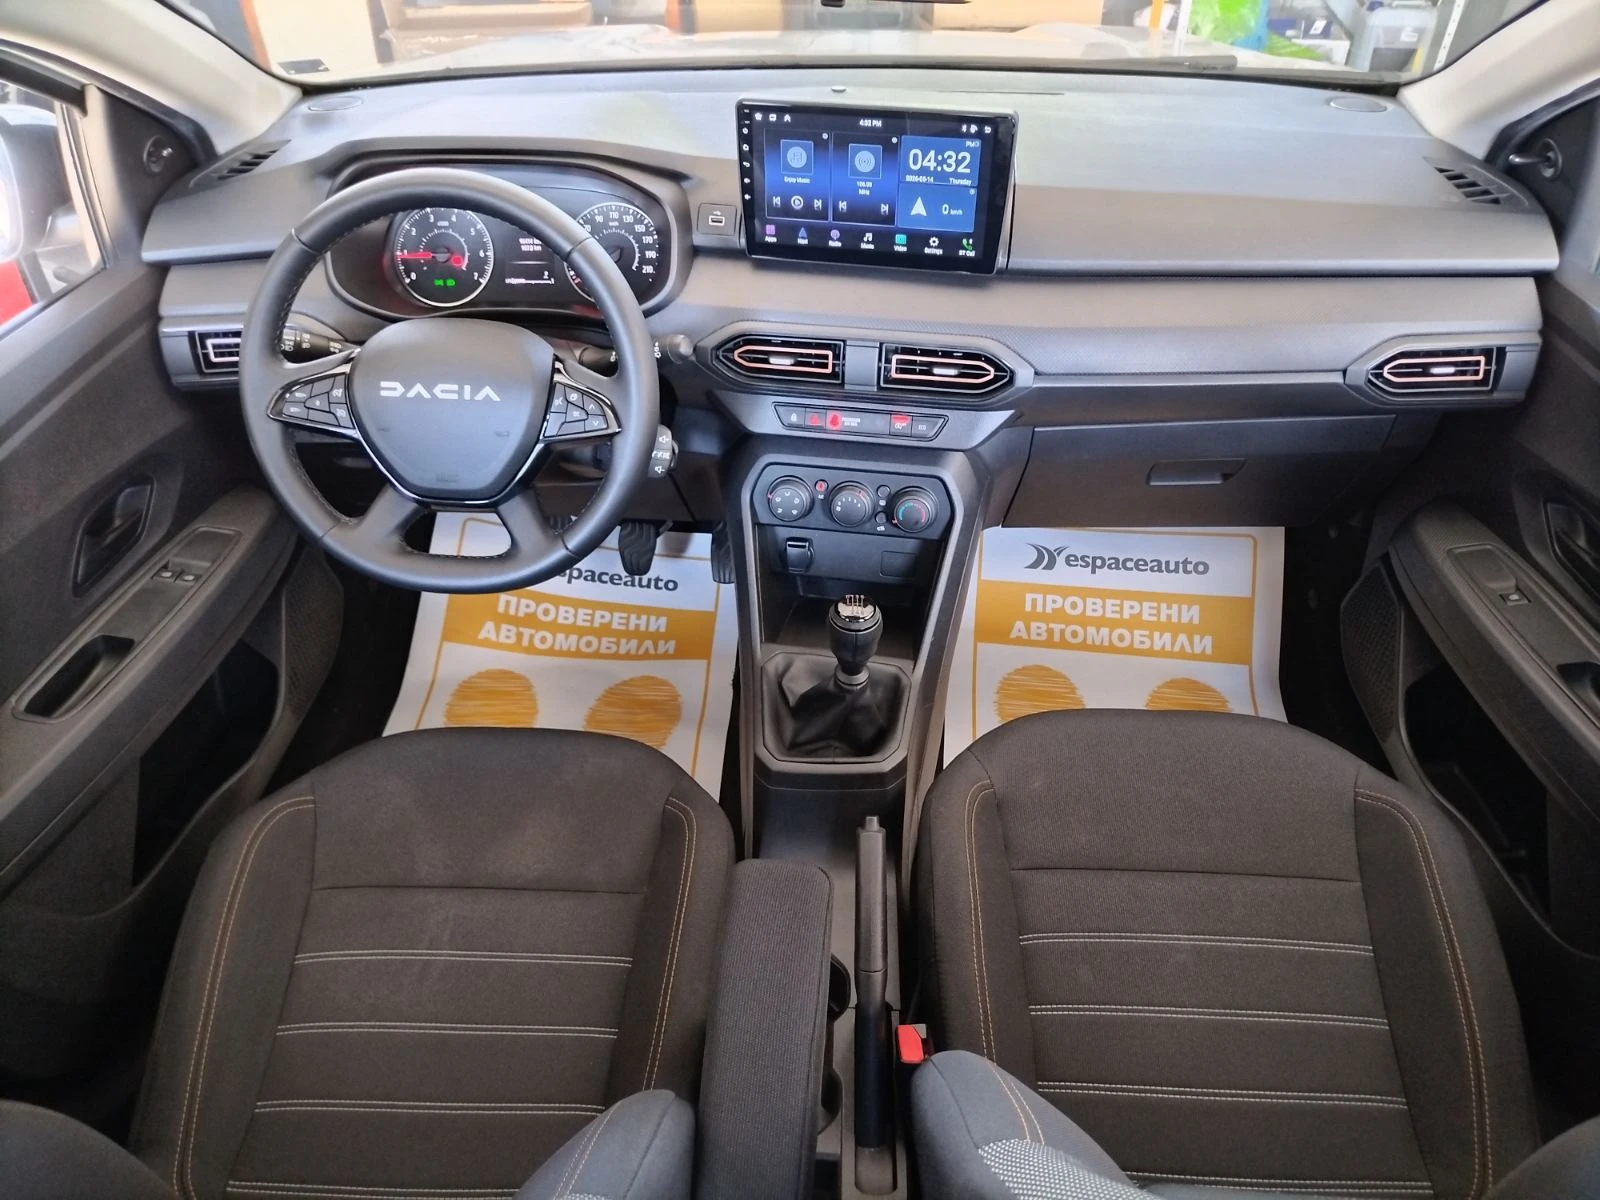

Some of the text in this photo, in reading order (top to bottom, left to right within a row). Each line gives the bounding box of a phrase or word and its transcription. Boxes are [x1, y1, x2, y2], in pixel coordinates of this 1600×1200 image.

[909, 148, 971, 174] 04:32
[609, 211, 619, 219] 110
[942, 204, 950, 215] 0
[595, 215, 604, 223] 90
[623, 215, 634, 223] 130
[634, 224, 646, 232] 150
[642, 236, 653, 244] 170
[645, 250, 656, 259] 190
[642, 265, 653, 274] 210
[379, 381, 501, 402] DACIA
[1065, 552, 1210, 575] espaceauto
[559, 566, 679, 592] paceauto
[497, 594, 668, 633] ПРОВЕРЕНИ
[1024, 592, 1200, 625] ПРОВЕРЕНИ
[478, 621, 676, 655] АВТОМОБИЛИ
[1010, 620, 1213, 656] АВТОМОБИЛИ
